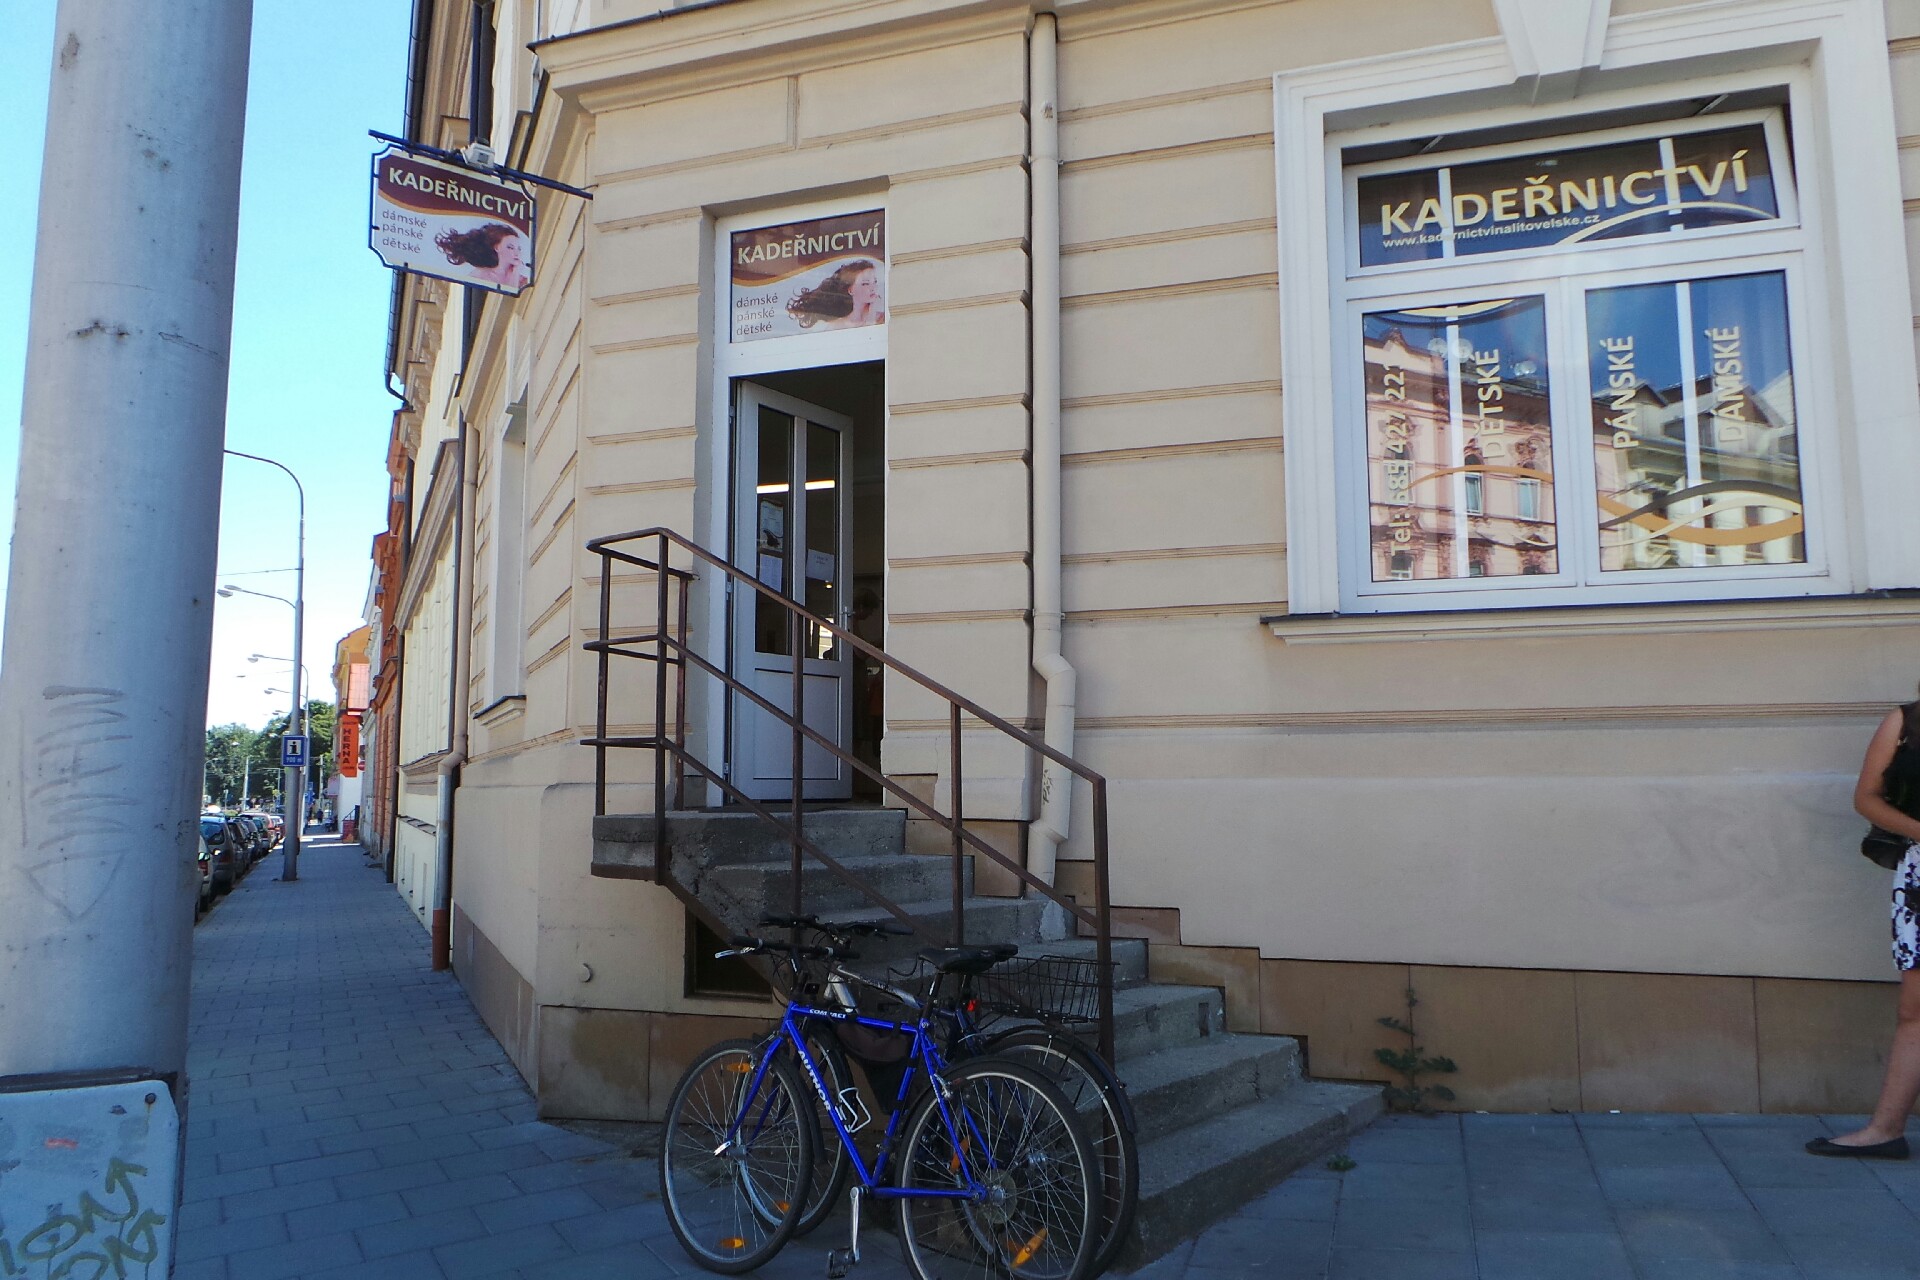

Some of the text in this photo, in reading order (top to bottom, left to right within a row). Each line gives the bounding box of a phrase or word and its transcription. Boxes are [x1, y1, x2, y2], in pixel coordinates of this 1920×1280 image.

[389, 167, 526, 220] KADEŘNICTVÍ
[1381, 149, 1749, 236] KADEŘNICTVÍ
[382, 209, 427, 229] dámské
[382, 222, 424, 240] pánské
[382, 237, 421, 254] dětské
[737, 222, 881, 265] KADEŘNICTVÍ
[736, 292, 778, 308] dámské
[736, 307, 775, 323] pánské
[736, 321, 772, 336] dětské
[1468, 349, 1504, 458] DĚTSKÉ
[1600, 335, 1639, 449] PÁNSKÉ
[1704, 326, 1746, 441] DÁMSKÉ
[1385, 409, 1407, 455] 427
[1388, 513, 1411, 557] Tel:
[343, 728, 352, 764] HERNA
[798, 1050, 831, 1112] AUTHOR
